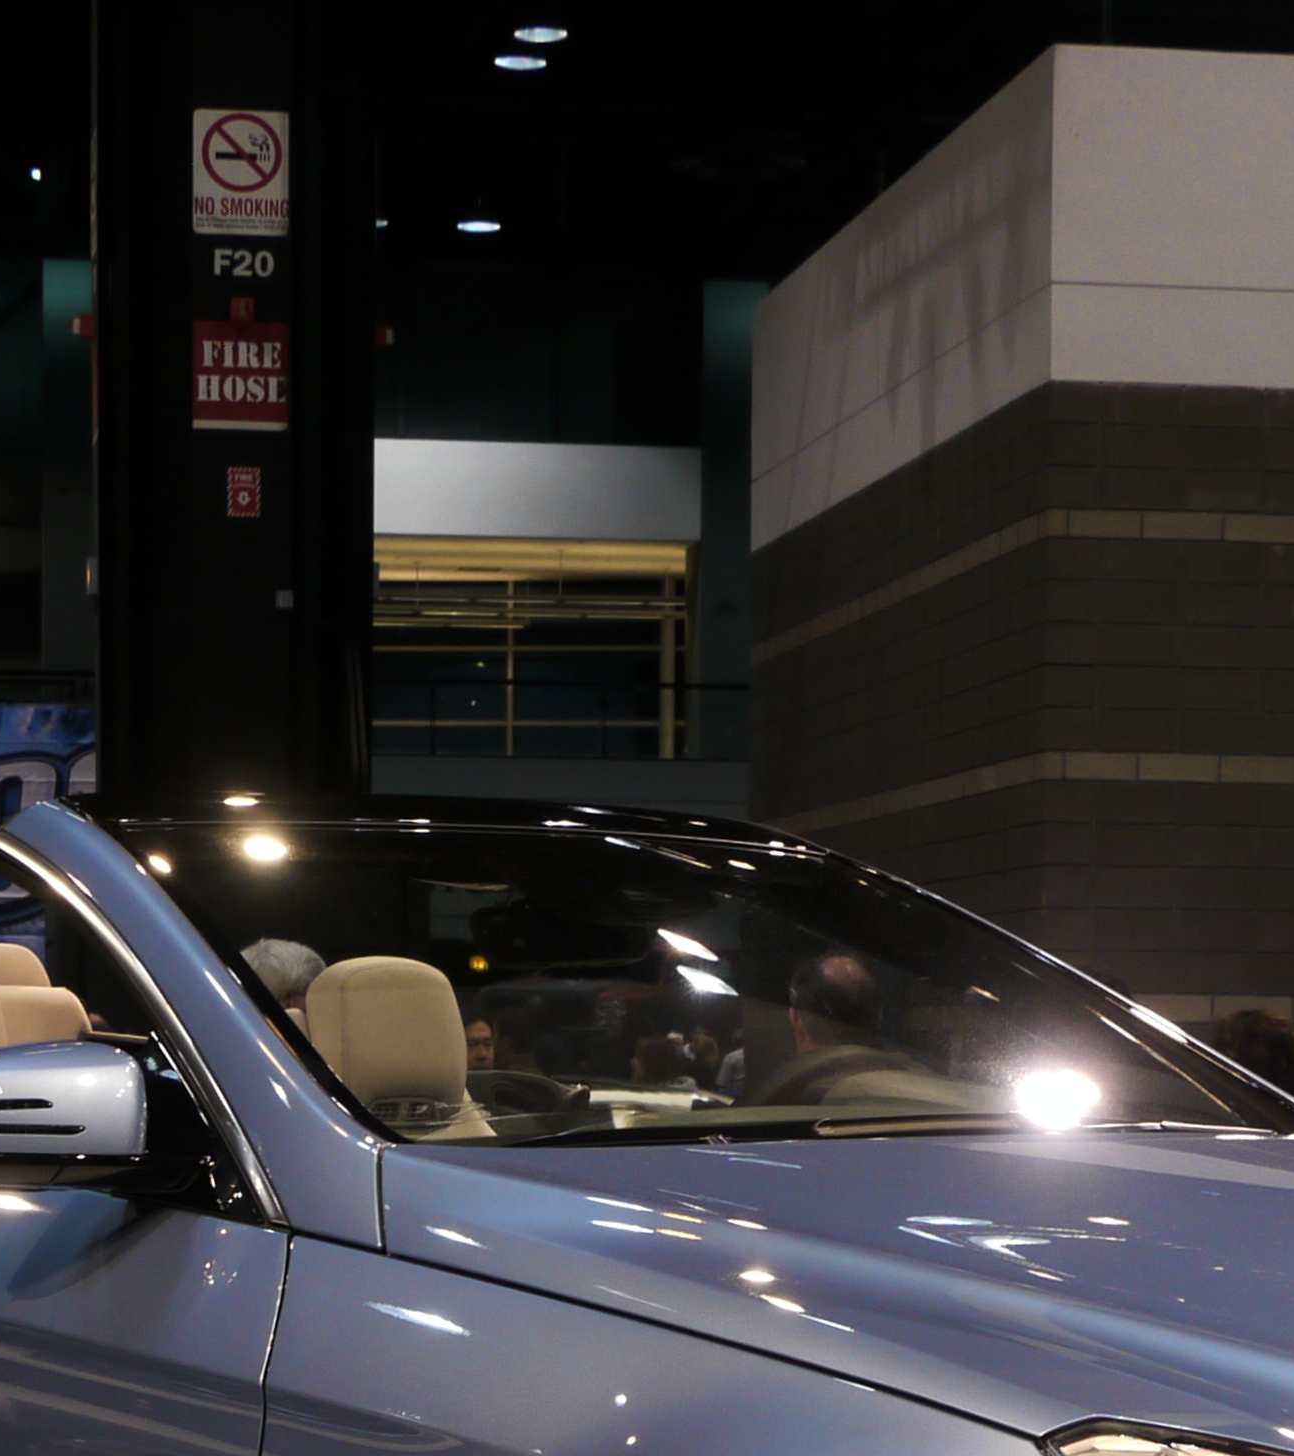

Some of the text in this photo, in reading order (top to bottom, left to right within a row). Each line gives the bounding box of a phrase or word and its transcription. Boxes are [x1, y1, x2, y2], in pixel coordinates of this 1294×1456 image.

[194, 196, 289, 218] NO SMOKING
[213, 248, 275, 277] F20
[201, 340, 282, 369] FIRE
[196, 374, 287, 403] HOSE
